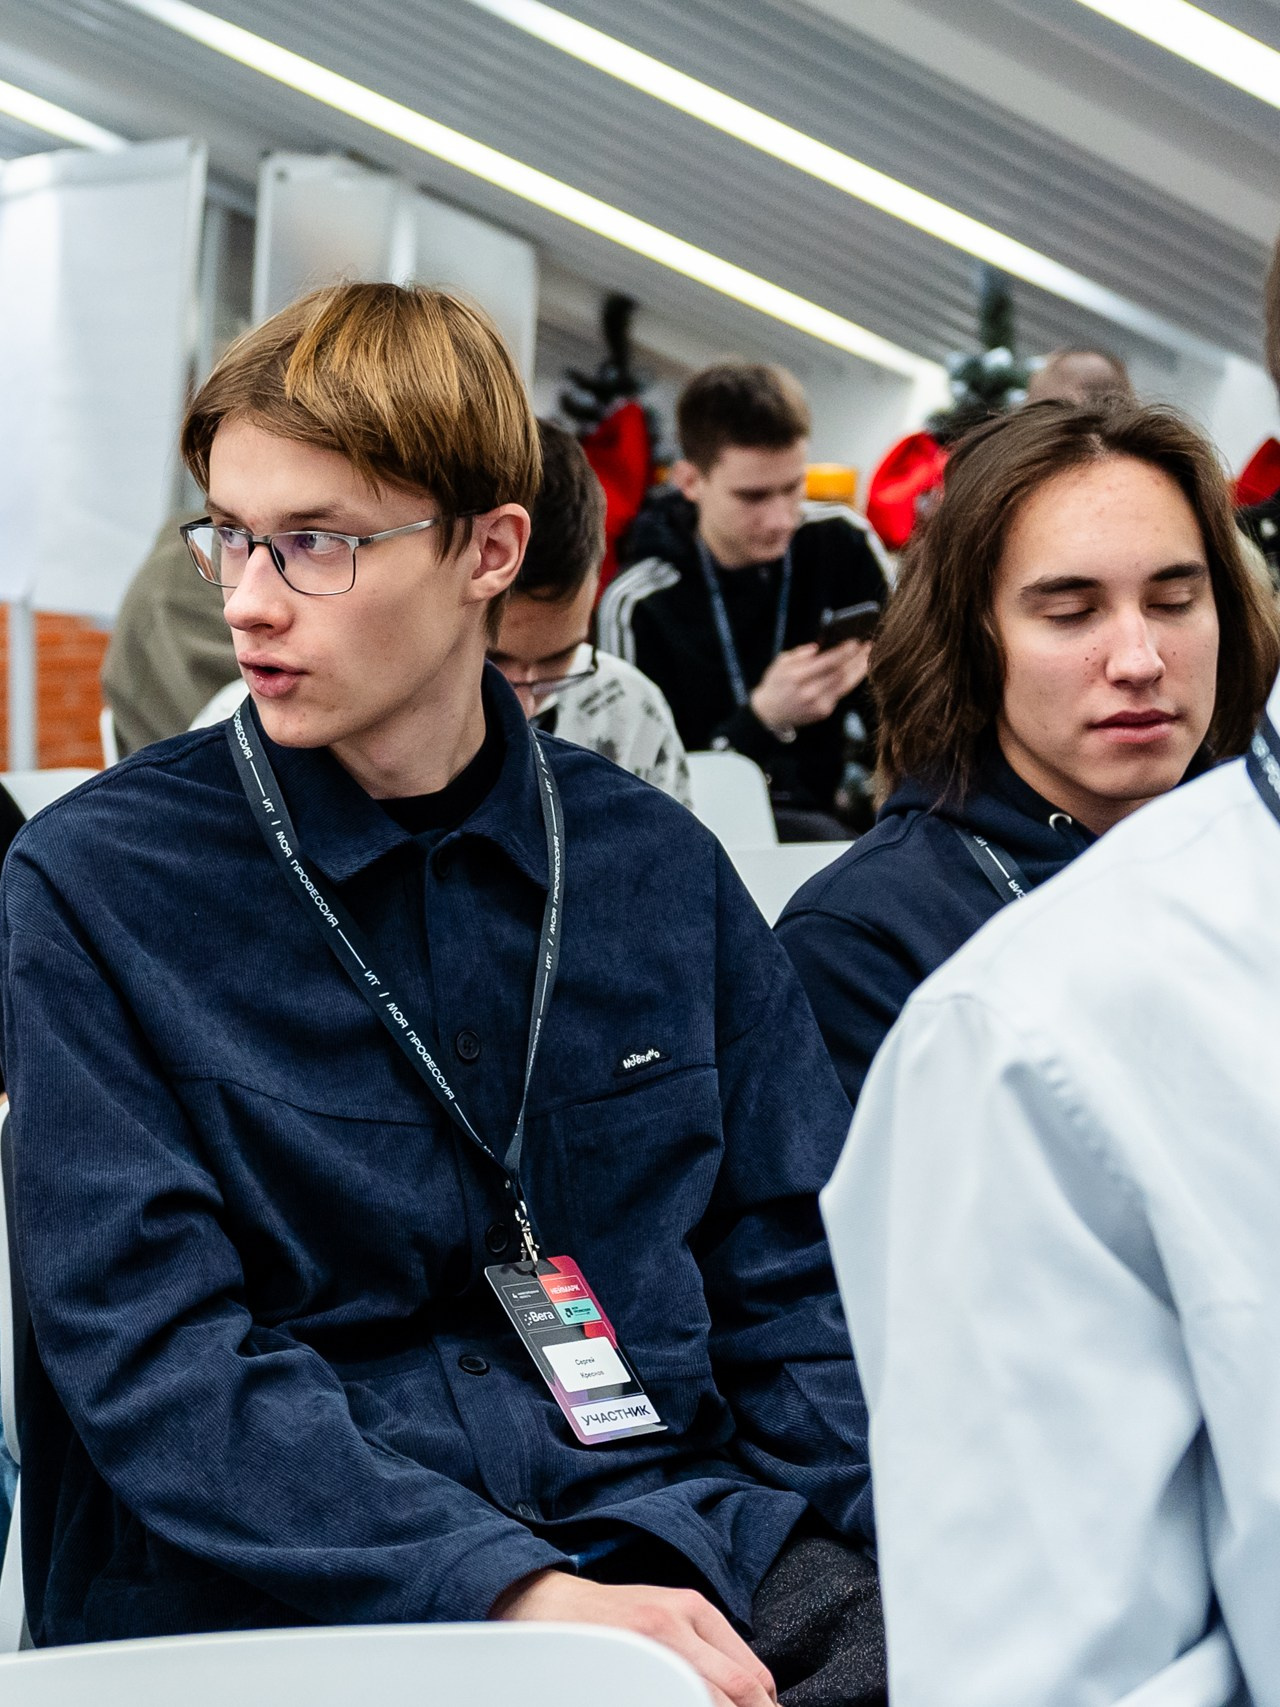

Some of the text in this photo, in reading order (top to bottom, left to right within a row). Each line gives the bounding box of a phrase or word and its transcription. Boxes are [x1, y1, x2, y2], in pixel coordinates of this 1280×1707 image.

[550, 908, 558, 935] МОЯ
[263, 798, 275, 813] ИТ
[276, 831, 292, 858] МОЯ
[290, 859, 339, 928] ПРОФЕССИЯ
[364, 970, 380, 986] ИТ
[386, 1003, 409, 1029] МОЯ
[406, 1030, 455, 1101] ПРОФЕССИЯ
[531, 1311, 555, 1323] Вега
[575, 1356, 595, 1367] Сергей
[581, 1405, 651, 1426] УЧАСТНИК
